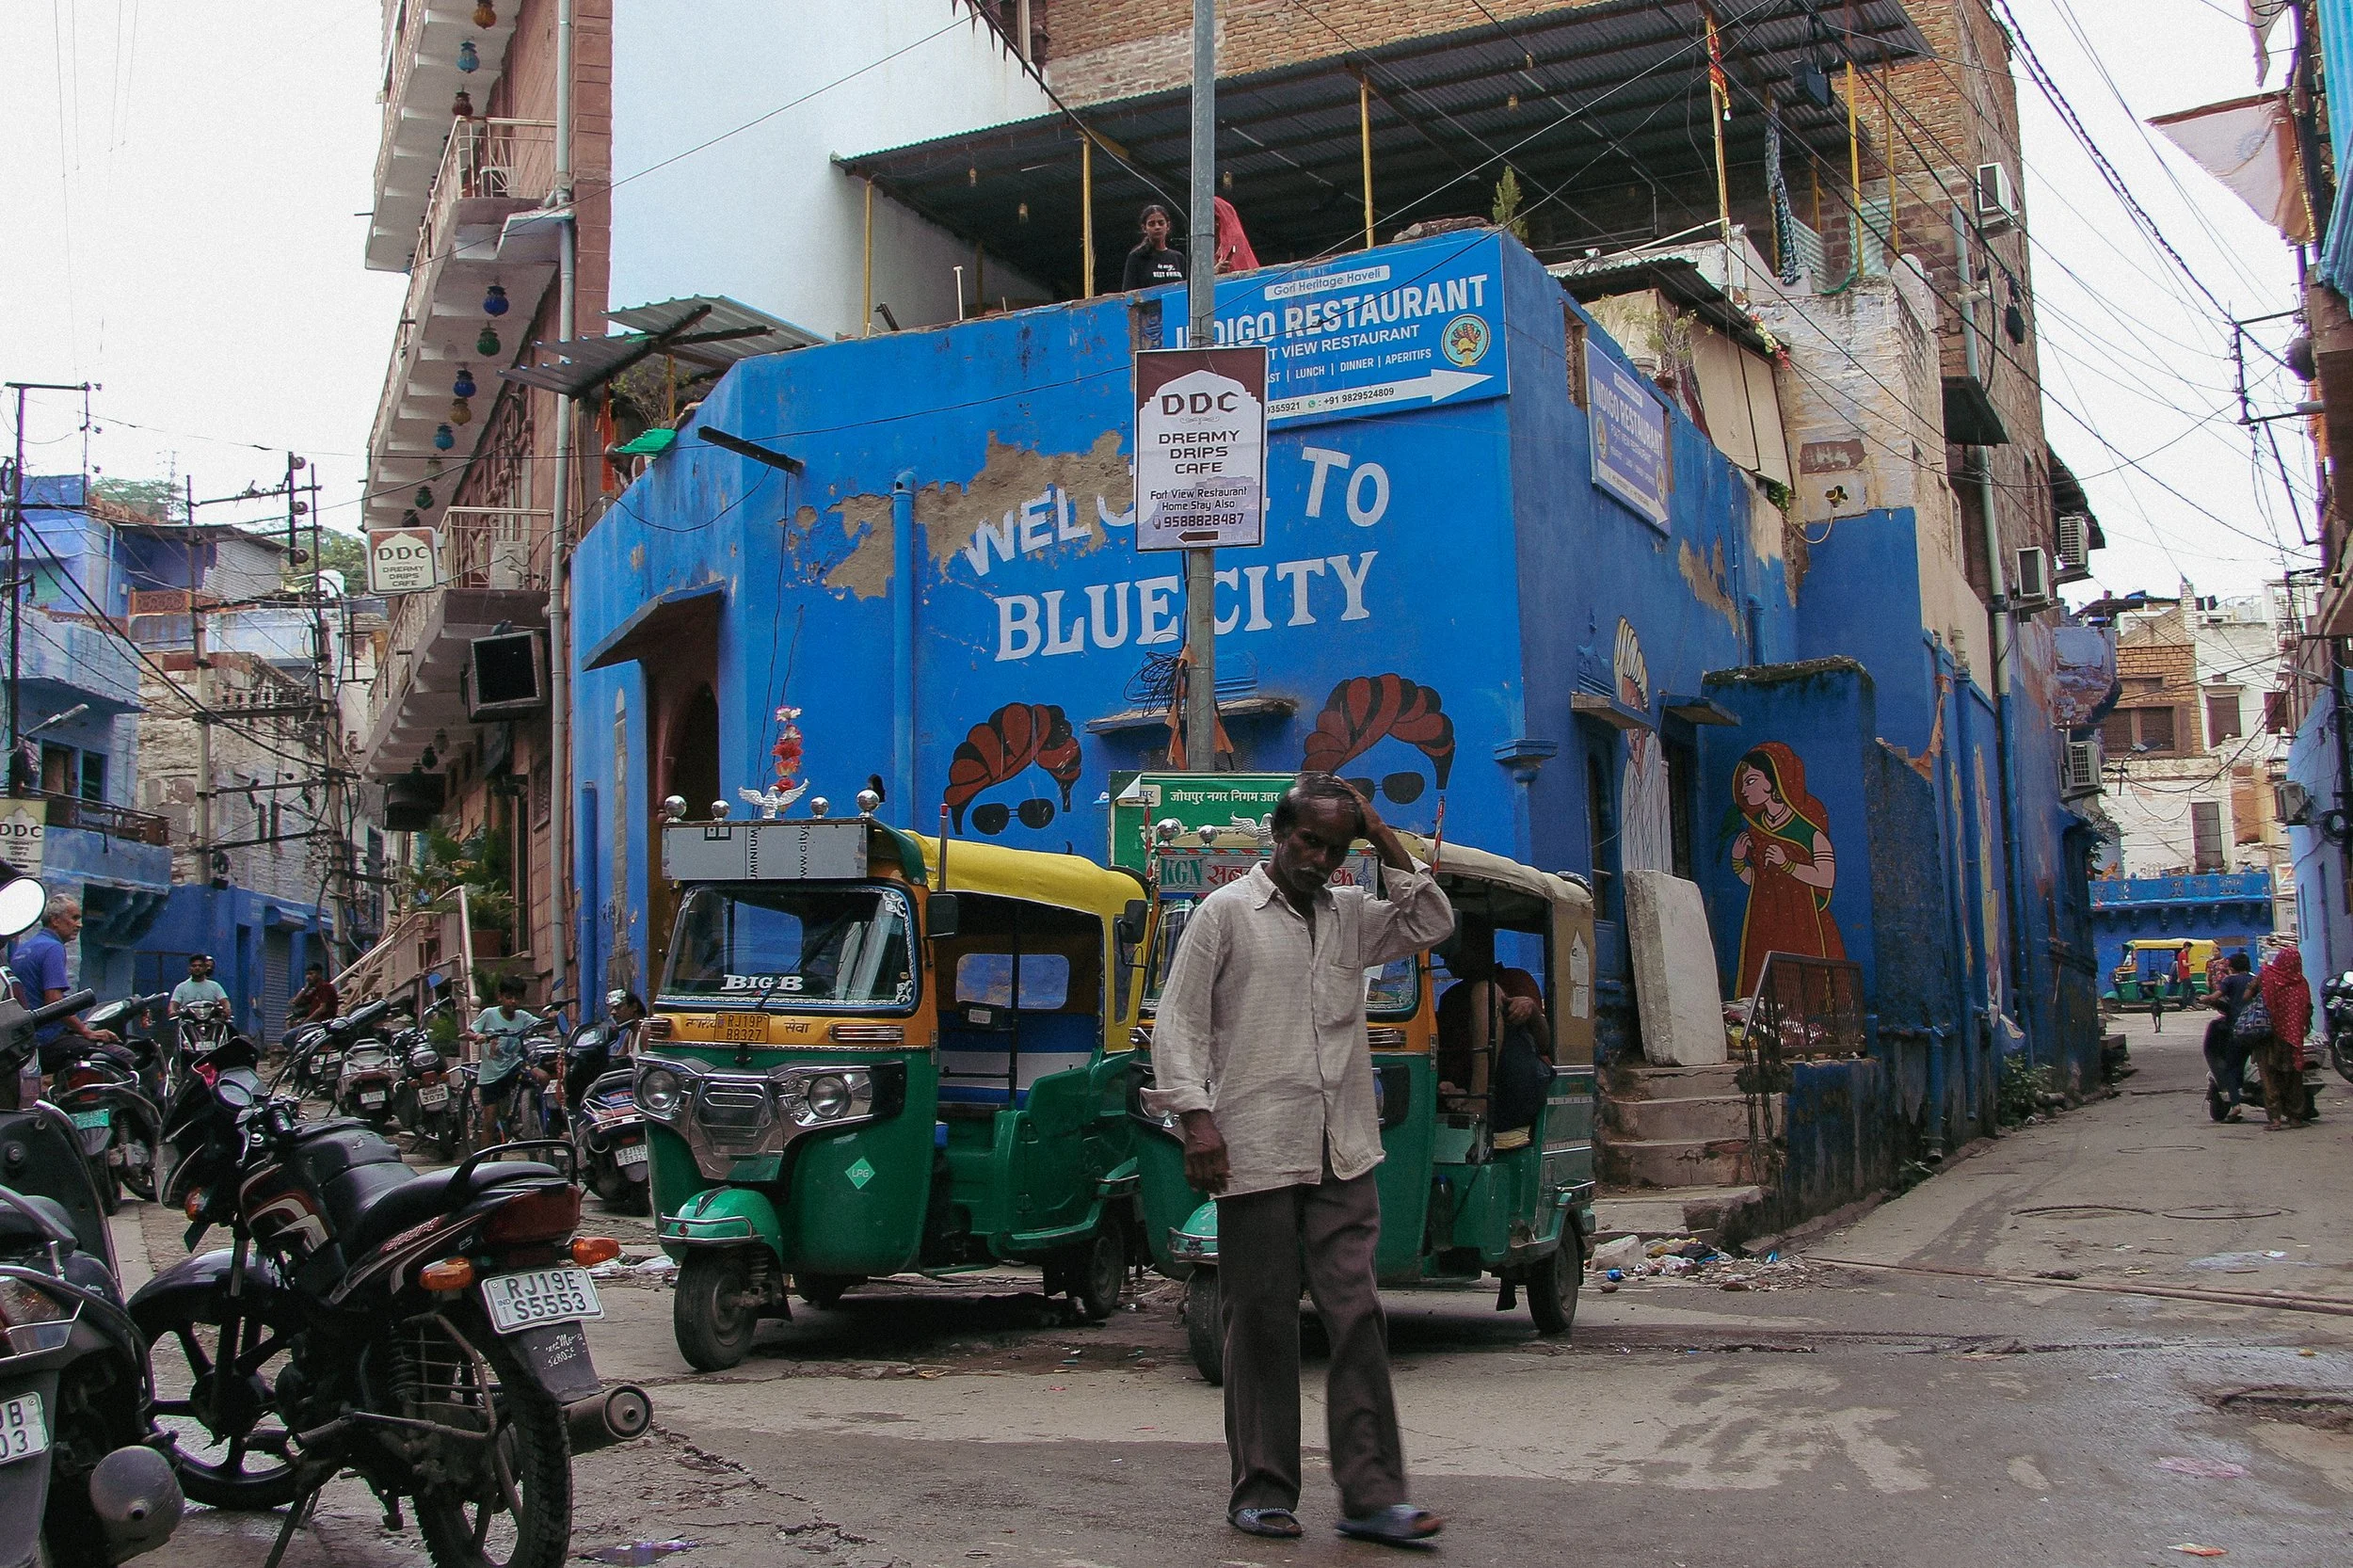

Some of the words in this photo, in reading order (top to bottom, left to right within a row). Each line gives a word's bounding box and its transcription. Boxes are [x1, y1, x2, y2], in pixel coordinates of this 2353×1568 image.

[1273, 283, 1296, 296] Gori
[1299, 276, 1344, 294] Heritage
[1347, 269, 1382, 284] Haveli
[1176, 312, 1276, 349] IDIGO
[1285, 274, 1488, 339] RESTAURANT
[1281, 340, 1318, 360] VIEW
[1321, 325, 1420, 352] RESTAURANT
[1295, 365, 1325, 380] LUNCH
[1340, 358, 1374, 373] DINNER
[1385, 348, 1432, 366] APERITIFS
[1160, 391, 1239, 416] DDC
[1323, 395, 1339, 406] +91
[1342, 387, 1395, 404] 9829524809
[1592, 376, 1619, 423] INDIGO
[1620, 399, 1662, 460] RESTAURANT
[1159, 429, 1240, 444] DREAMY
[1170, 445, 1228, 459] DRIPS
[1175, 461, 1223, 474] CAFE
[1150, 489, 1168, 501] Fort
[1171, 488, 1194, 499] View
[1197, 486, 1247, 499] Restaurant
[1301, 445, 1390, 528] TO
[1161, 502, 1188, 511] Home
[1191, 500, 1211, 512] Stay
[1214, 500, 1235, 509] Also
[1163, 512, 1244, 528] 9588828487
[378, 546, 428, 560] DDC
[993, 574, 1179, 662] BLUE
[1170, 789, 1206, 805] जोधपुर
[1207, 791, 1228, 803] नगर
[1230, 789, 1259, 802] निगम
[1160, 856, 1206, 887] KGN
[720, 973, 774, 991] BIG
[727, 1015, 764, 1028] RJ19P
[783, 1018, 811, 1034] सेवा
[726, 1029, 762, 1042] B8327
[423, 1093, 445, 1103] 3075
[852, 1169, 870, 1178] LPG
[458, 1235, 473, 1251] ES
[504, 1271, 581, 1300] RJ19E
[497, 1298, 511, 1306] IND
[513, 1291, 586, 1320] S5553
